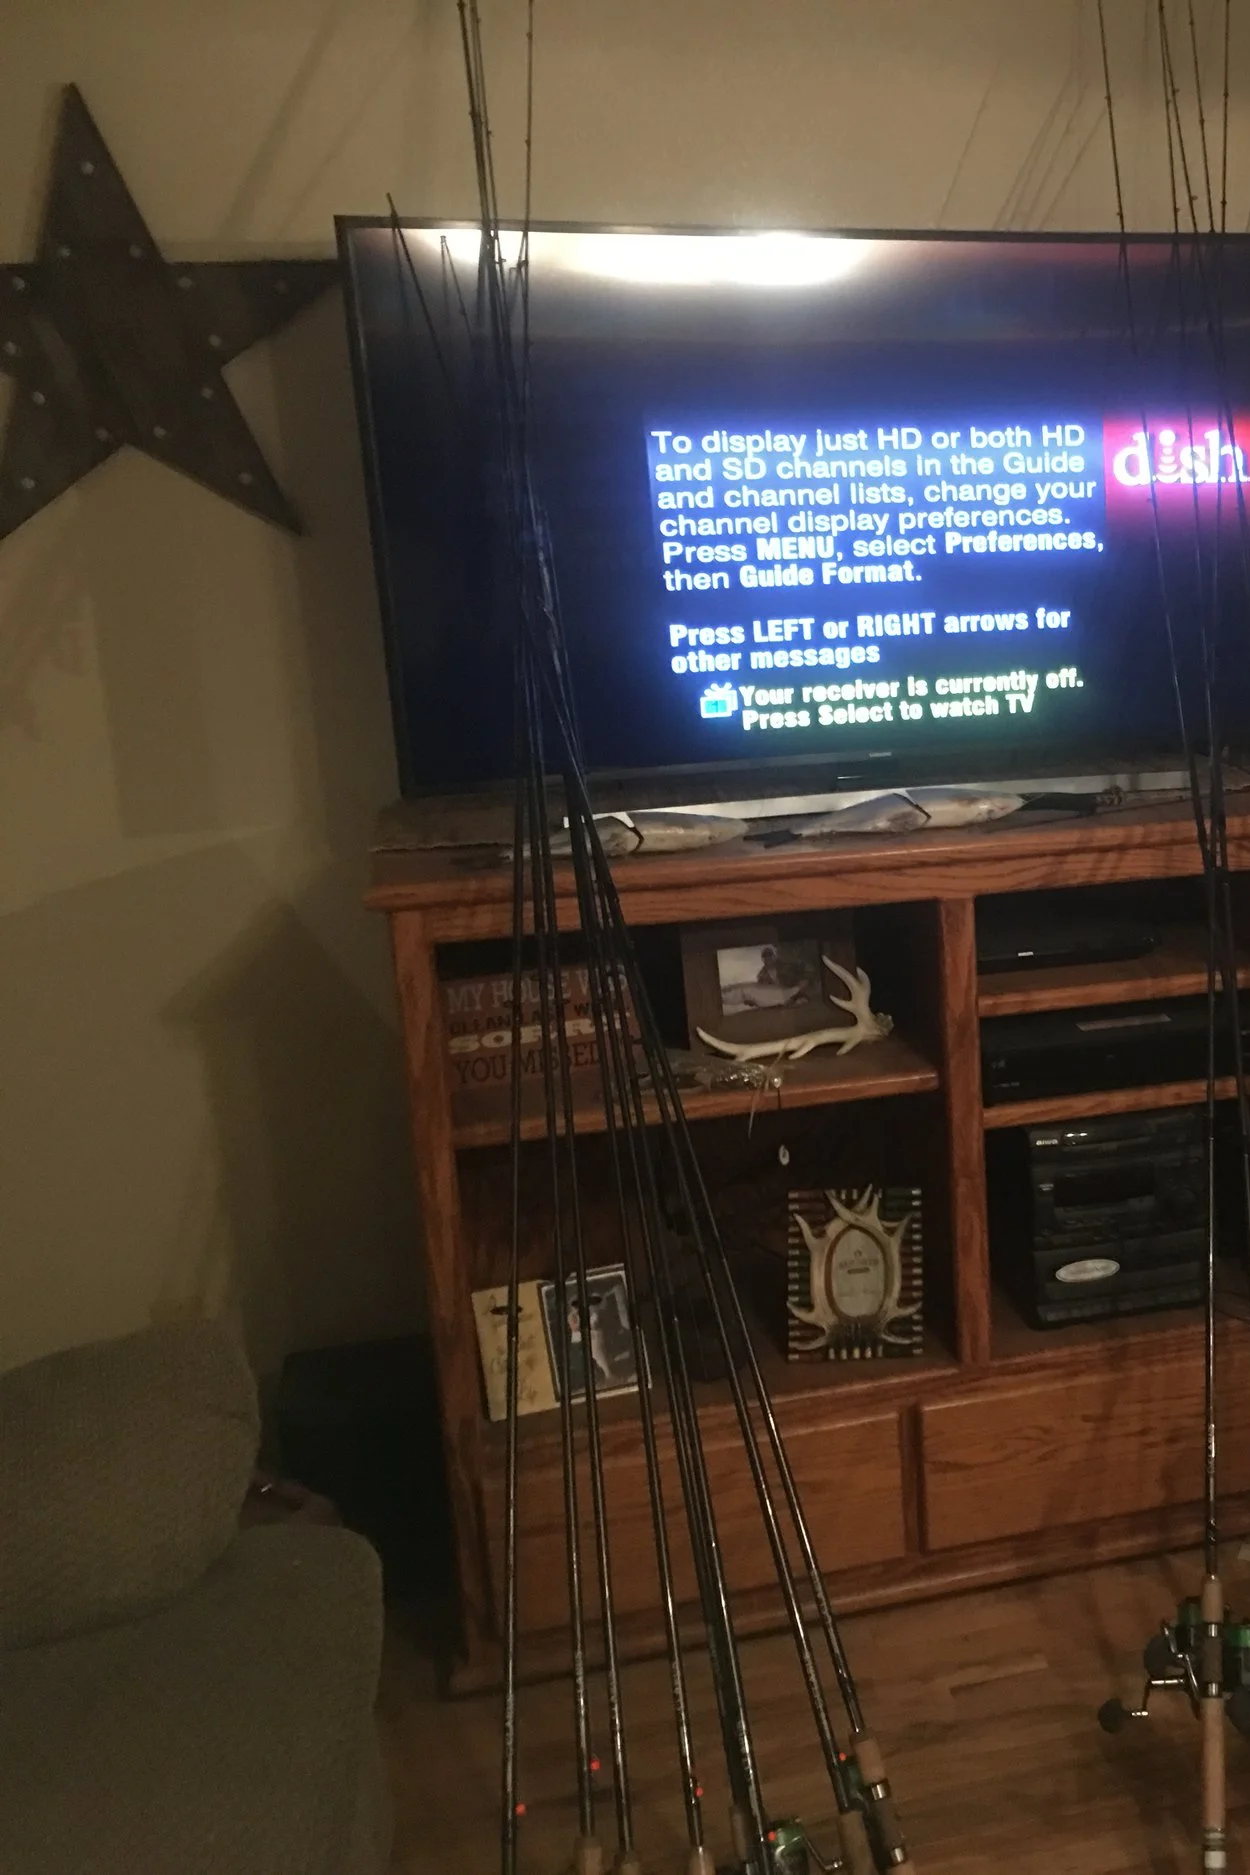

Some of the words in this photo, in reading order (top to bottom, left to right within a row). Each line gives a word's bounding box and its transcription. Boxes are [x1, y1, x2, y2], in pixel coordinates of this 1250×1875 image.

[651, 430, 692, 454] To
[701, 430, 807, 457] display
[815, 428, 868, 456] just
[877, 427, 922, 450] HD
[931, 431, 961, 449] or
[970, 426, 1032, 449] both
[1042, 424, 1085, 447] HD
[655, 458, 712, 482] and
[722, 456, 767, 481] SD
[776, 454, 907, 479] channels
[916, 454, 941, 476] in
[950, 453, 995, 475] the
[1003, 451, 1085, 474] Guide
[1113, 429, 1250, 486] dish
[657, 485, 714, 509] and
[724, 483, 839, 507] channel
[851, 482, 914, 506] lists,
[924, 480, 1027, 506] change
[1035, 480, 1097, 504] your
[660, 511, 778, 537] channel
[787, 509, 889, 536] display
[899, 506, 1071, 534] preferences.
[662, 541, 748, 564] Press
[756, 535, 843, 561] MENU,
[853, 534, 936, 557] select
[945, 530, 1104, 554] Preferences,
[663, 568, 729, 591] then
[739, 563, 814, 588] Guide
[822, 560, 922, 585] Format.
[669, 623, 745, 647] Press
[753, 618, 815, 643] LEFT
[822, 621, 849, 639] or
[857, 612, 936, 638] RIGHT
[944, 611, 1029, 633] arrows
[1036, 607, 1071, 629] for
[671, 650, 742, 674] other
[750, 645, 880, 669] messages
[738, 685, 795, 706] Your
[802, 679, 900, 703] receiver
[907, 676, 928, 697] is
[935, 670, 1038, 697] currently
[1046, 667, 1084, 689] off.
[742, 710, 810, 730] Press
[818, 701, 894, 726] Select
[899, 700, 923, 720] to
[930, 695, 999, 718] watch
[1006, 693, 1035, 714] TV
[447, 982, 485, 1015] MY
[453, 1054, 508, 1085] YOU
